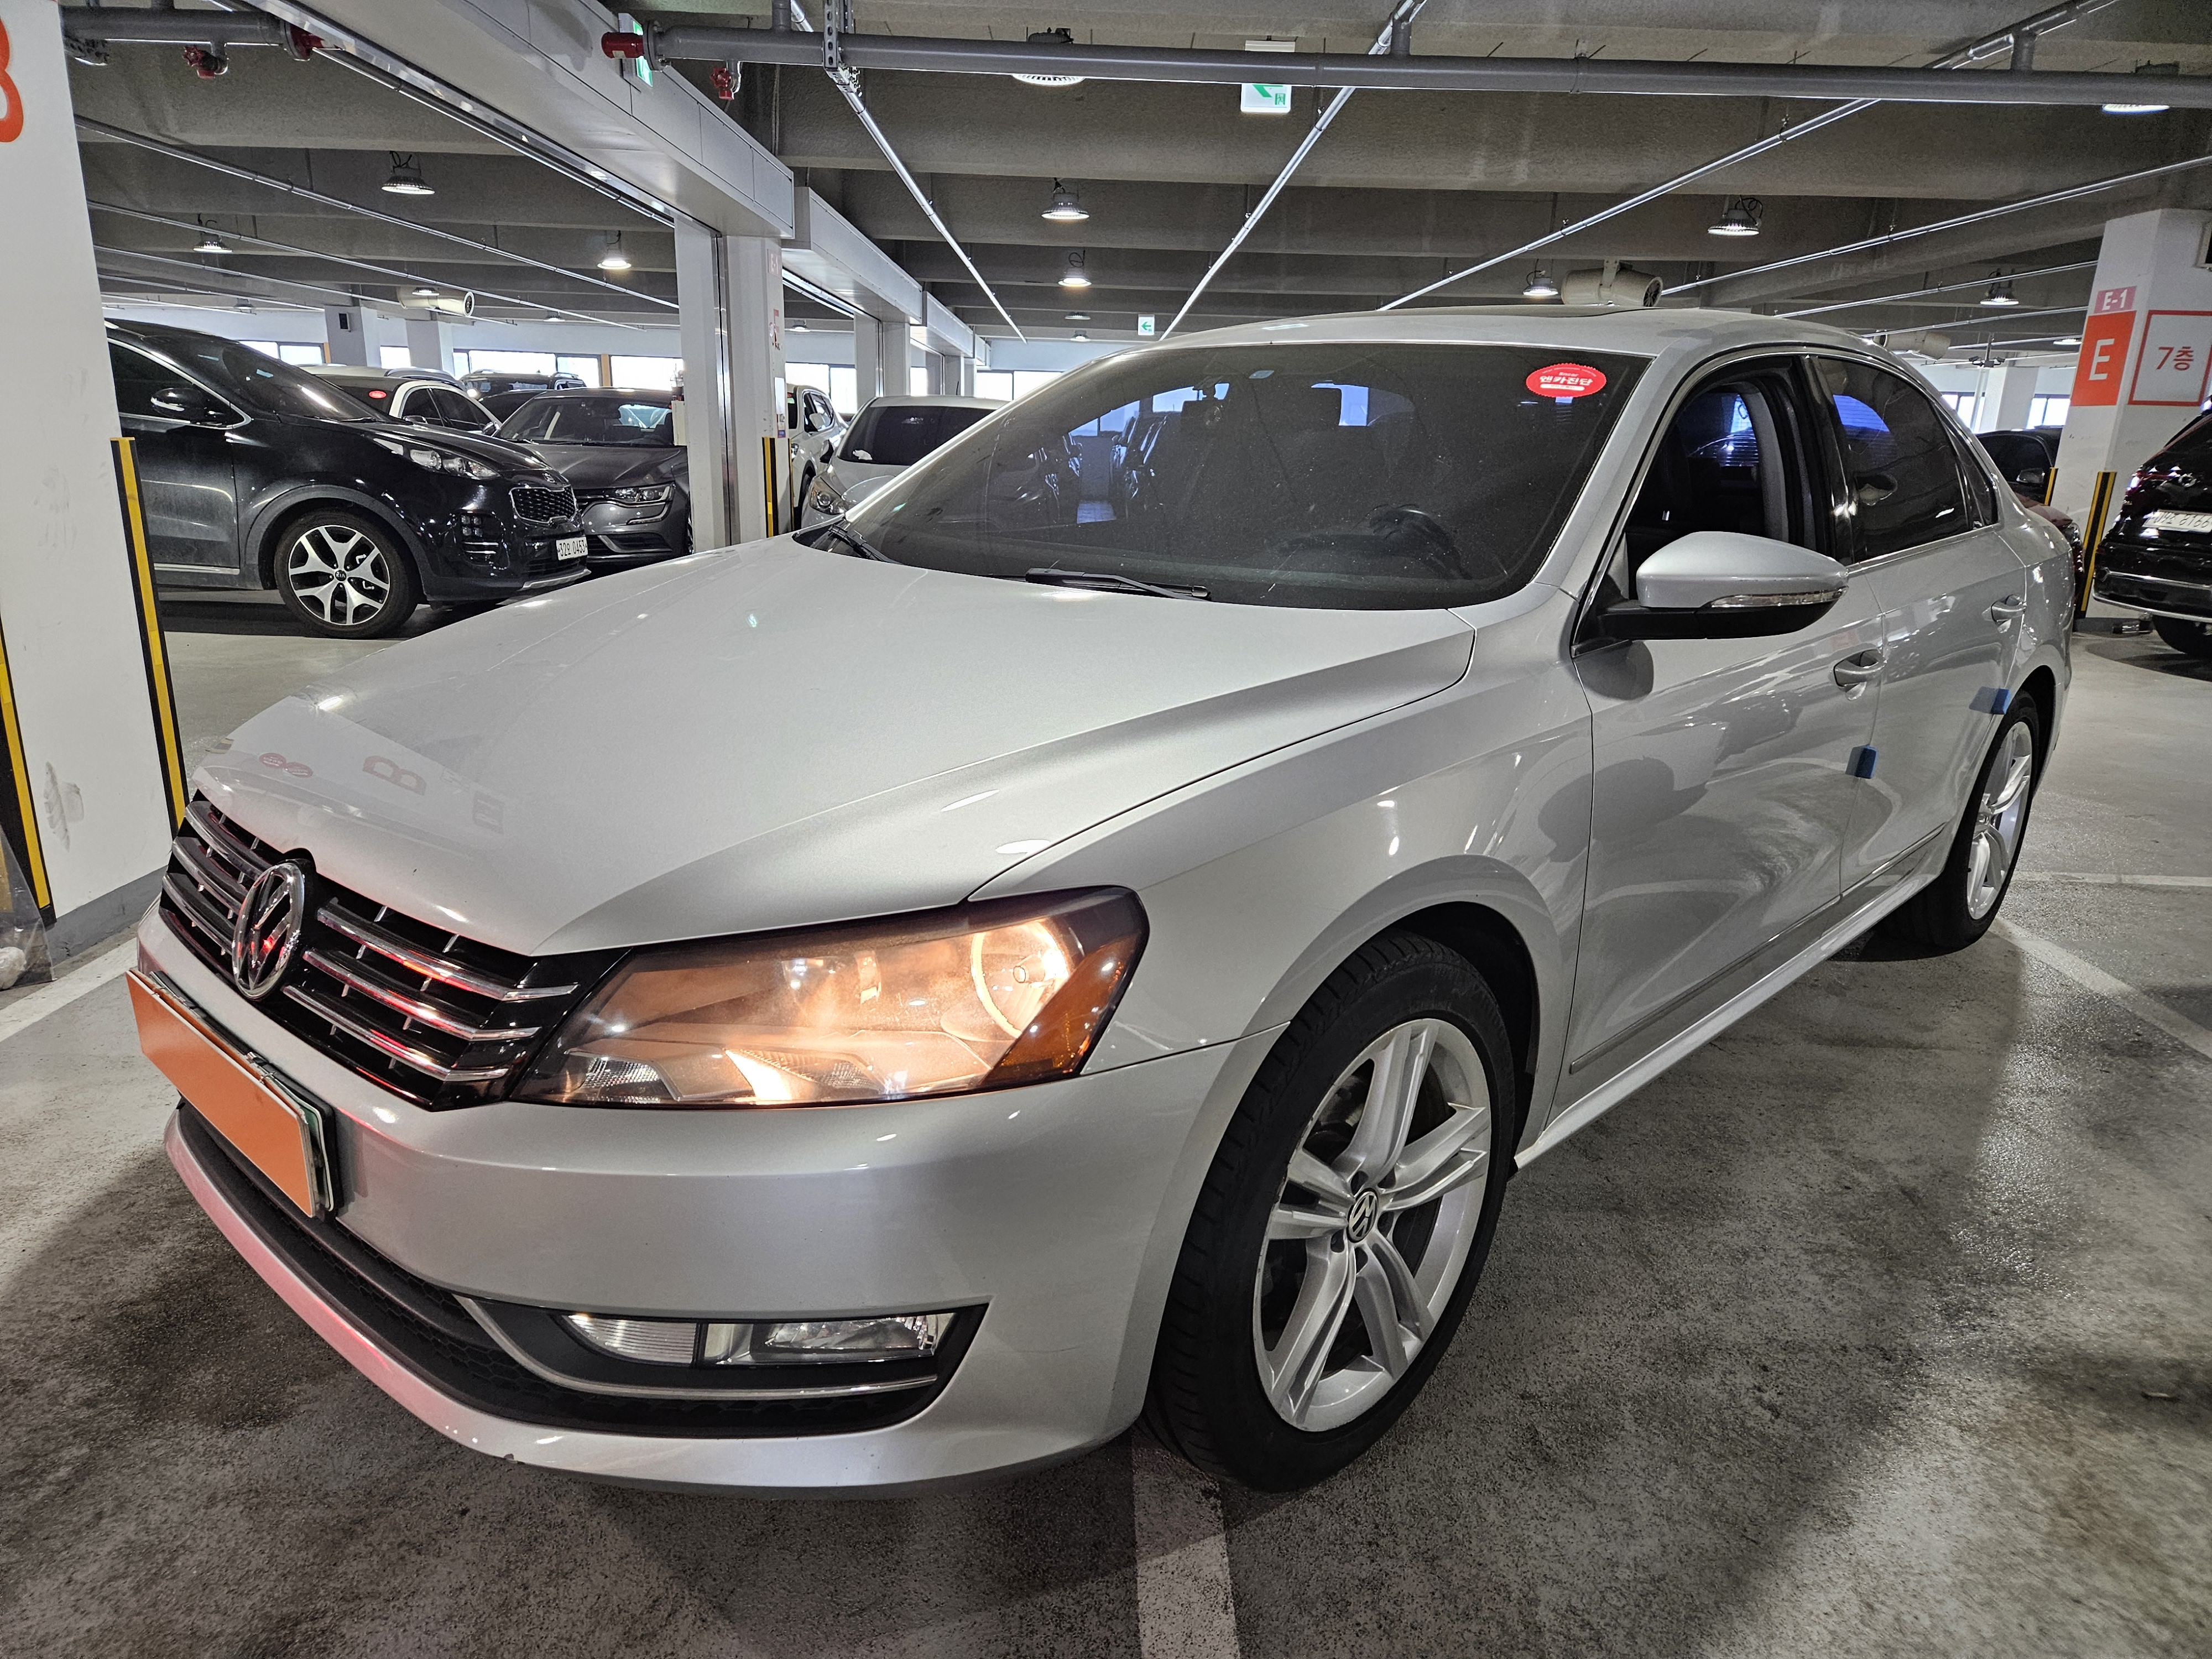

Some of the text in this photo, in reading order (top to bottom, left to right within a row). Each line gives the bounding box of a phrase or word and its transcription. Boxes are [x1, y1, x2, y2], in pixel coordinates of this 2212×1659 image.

[2102, 289, 2128, 311] E-1
[2088, 338, 2115, 381] E
[2156, 346, 2194, 371] 7층
[1539, 375, 1593, 387] 엔카진단
[572, 540, 586, 555] 0453
